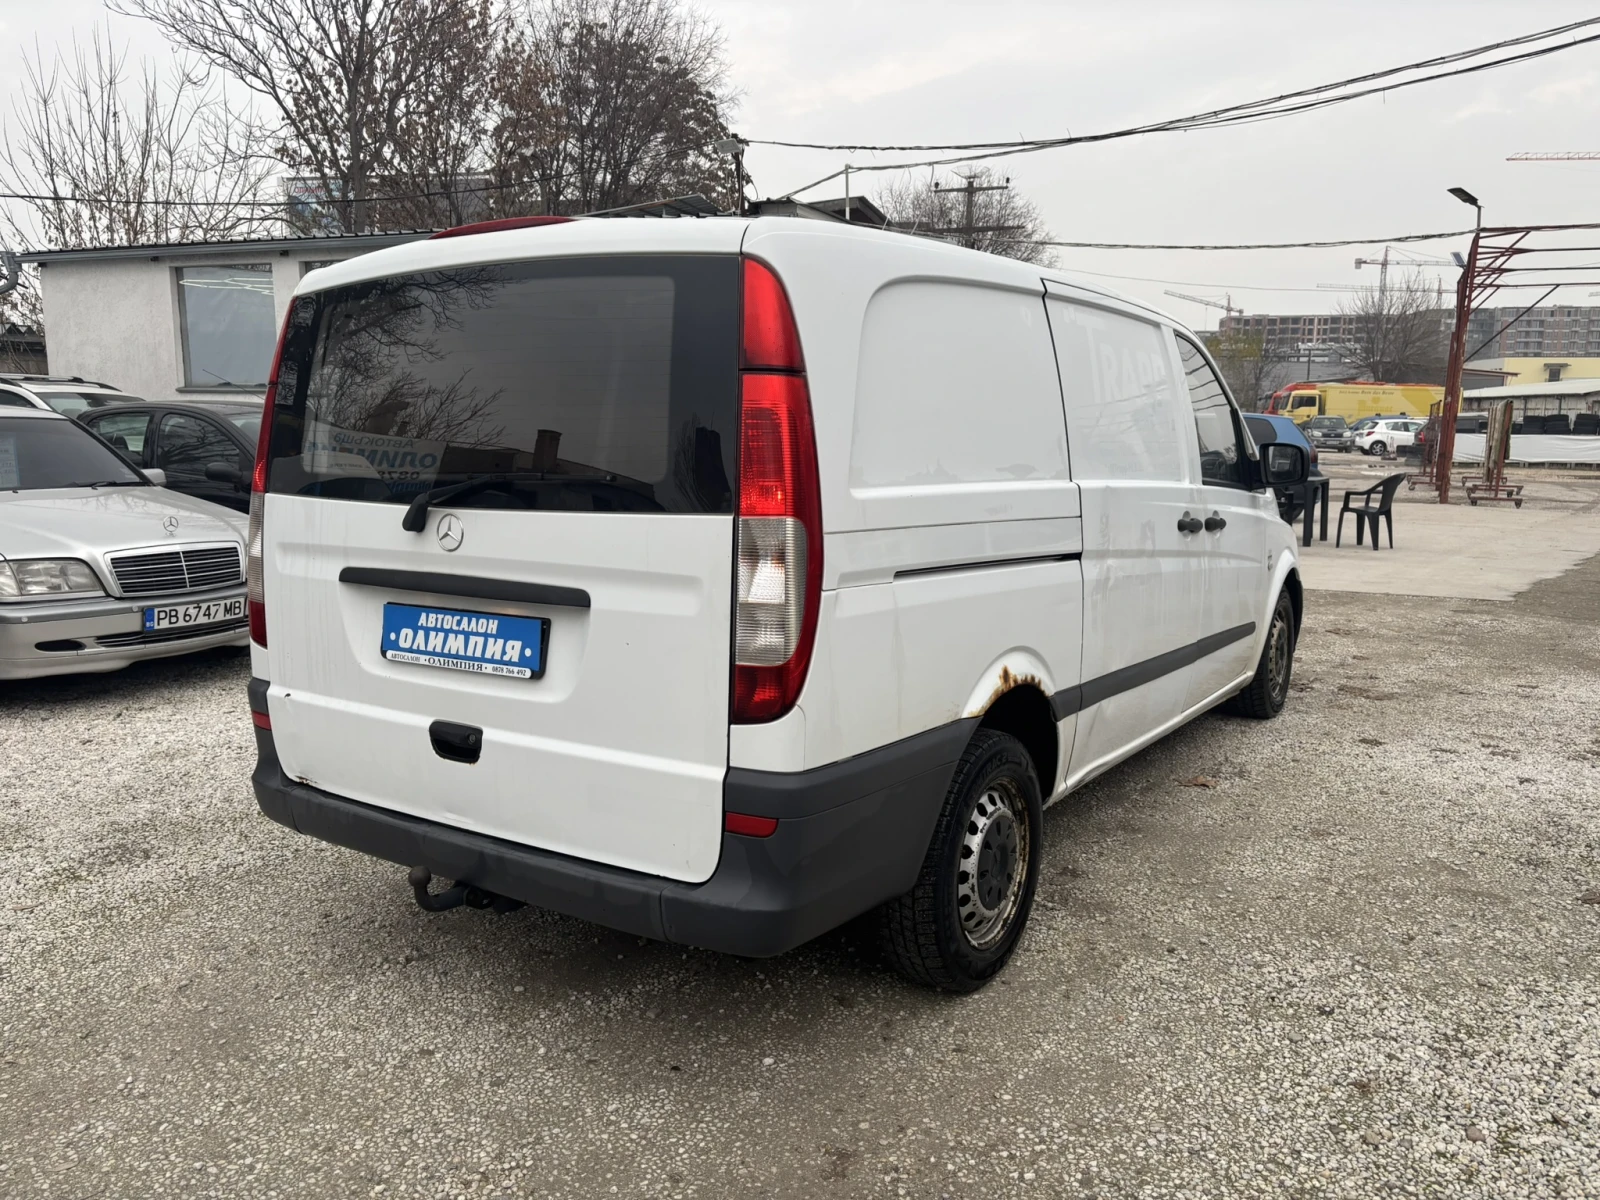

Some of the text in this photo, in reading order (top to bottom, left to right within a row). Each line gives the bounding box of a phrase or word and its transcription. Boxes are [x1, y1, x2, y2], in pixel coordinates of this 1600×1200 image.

[157, 600, 242, 627] PB 6747 MB
[418, 612, 499, 635] АВТОСАЛОН
[398, 628, 523, 662] ОЛИМПИЯ
[390, 653, 527, 677] АВТОСАЛОН ОЛИМПИЯ 0878 766 492
